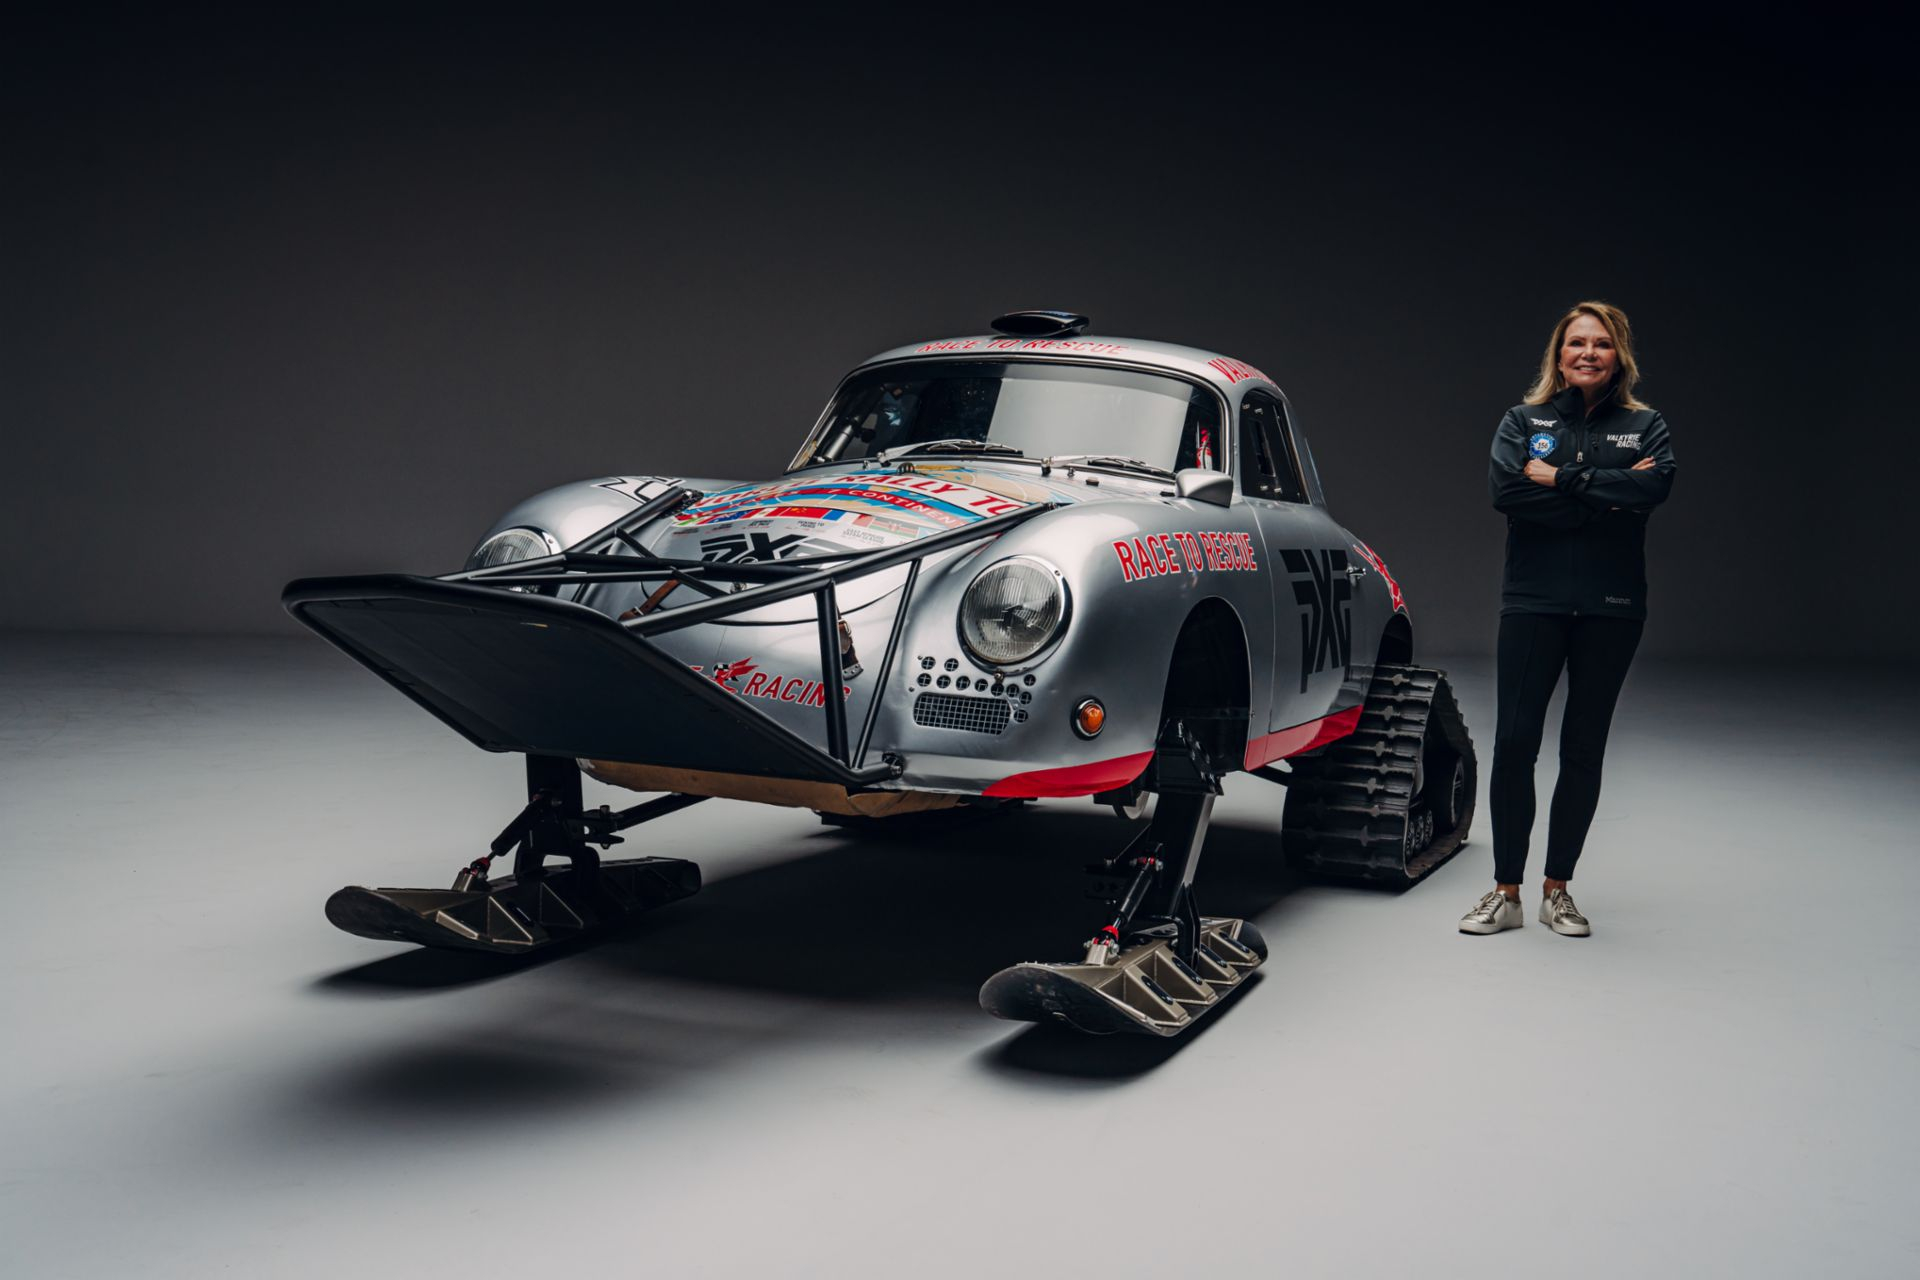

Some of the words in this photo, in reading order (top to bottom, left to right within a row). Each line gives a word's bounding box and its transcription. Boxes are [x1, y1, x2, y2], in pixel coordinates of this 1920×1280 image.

[917, 339, 983, 353] RACE
[986, 338, 1023, 349] TO
[1022, 339, 1130, 355] RESCUE
[1606, 433, 1641, 442] VALKYRIE
[1615, 440, 1641, 450] RACING
[832, 475, 969, 494] RALLY
[849, 489, 968, 529] CONTINENT
[1112, 534, 1181, 583] RACE
[1172, 531, 1203, 573] TO
[1197, 531, 1258, 571] RESCUE
